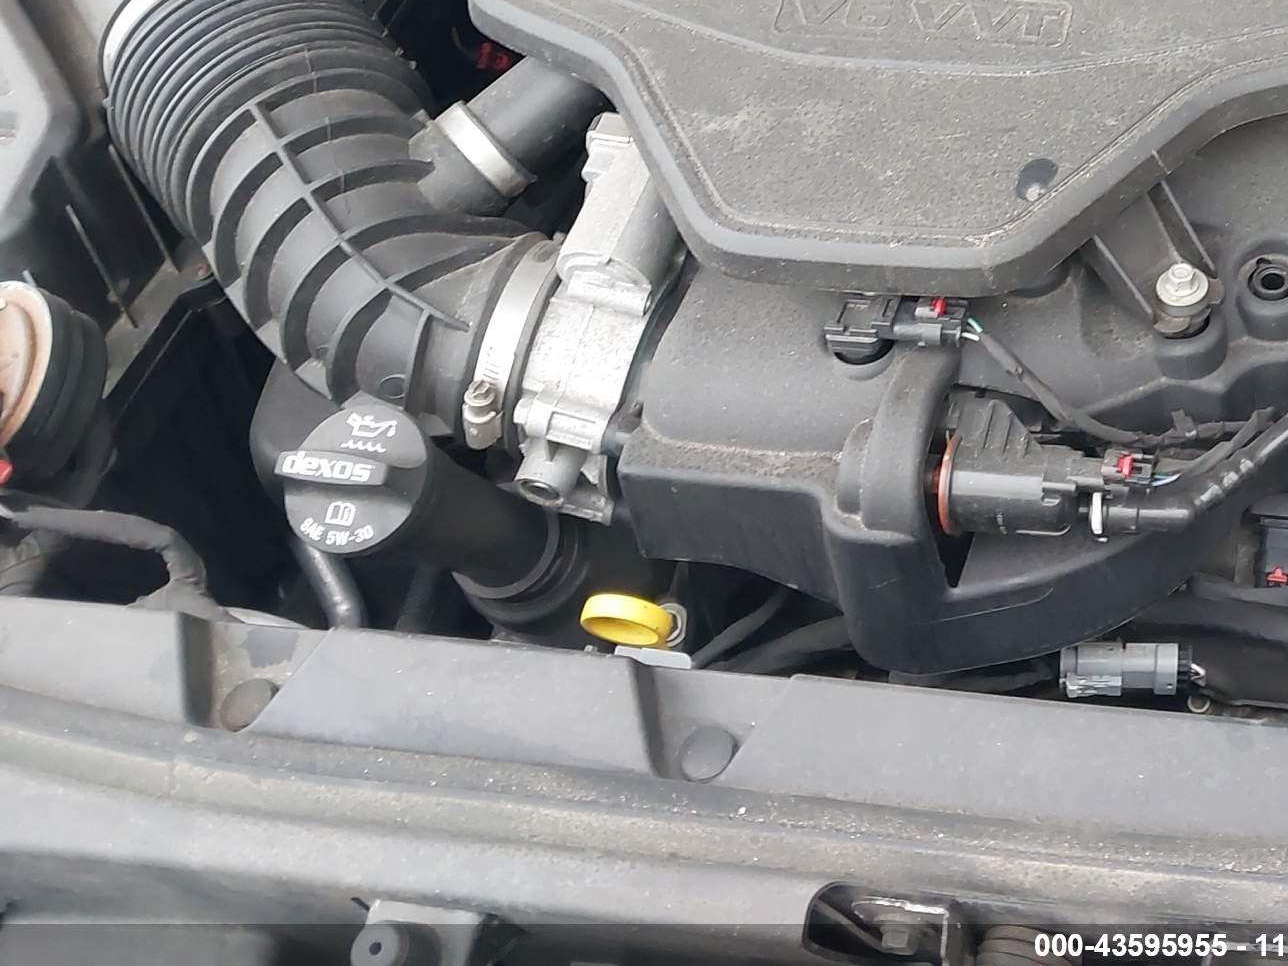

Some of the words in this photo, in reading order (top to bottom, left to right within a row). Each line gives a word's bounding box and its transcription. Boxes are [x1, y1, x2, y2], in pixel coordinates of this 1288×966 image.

[282, 450, 373, 482] dexos
[300, 517, 325, 542] SAE
[325, 524, 374, 547] 5W-30
